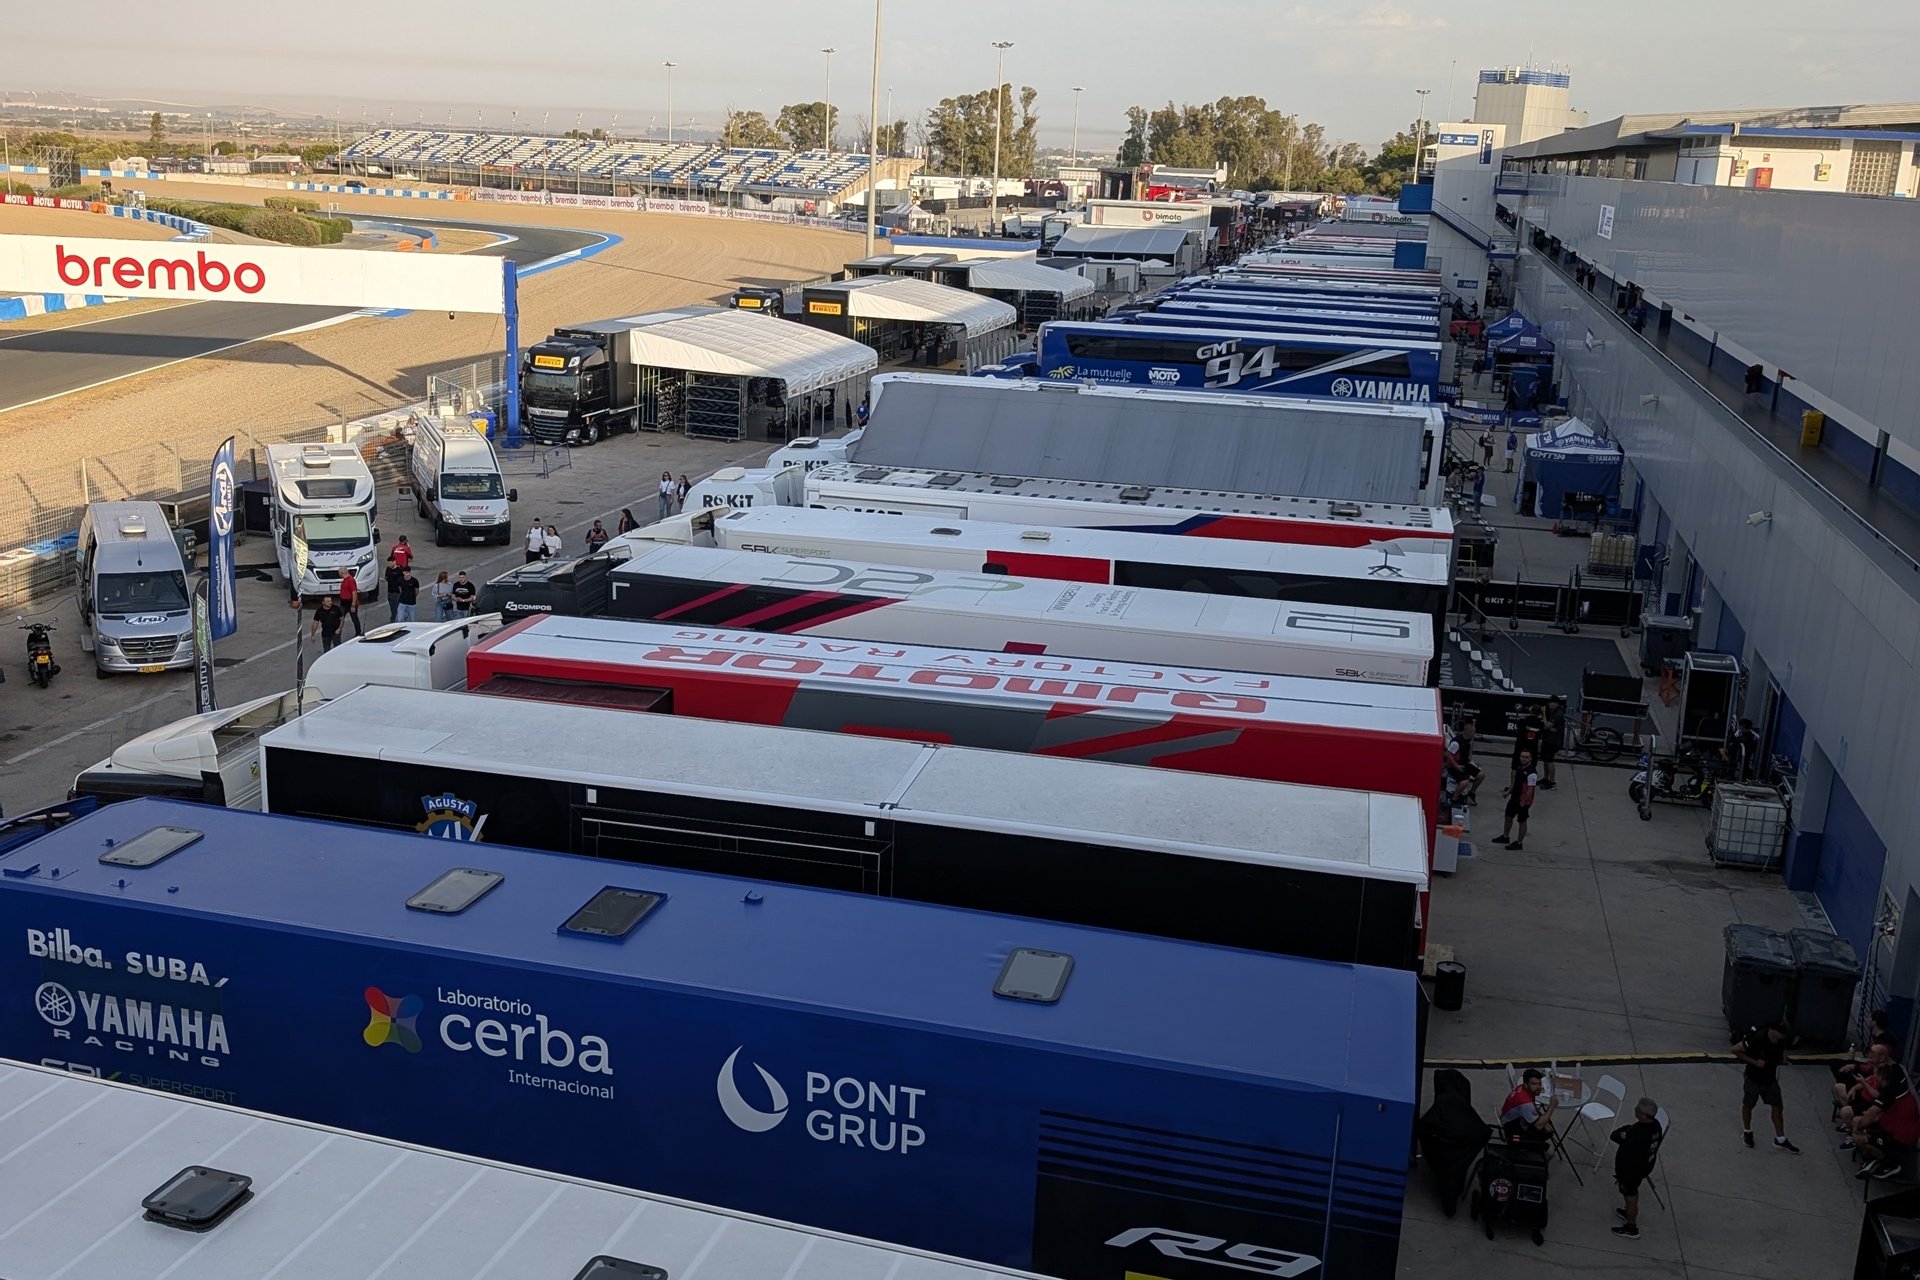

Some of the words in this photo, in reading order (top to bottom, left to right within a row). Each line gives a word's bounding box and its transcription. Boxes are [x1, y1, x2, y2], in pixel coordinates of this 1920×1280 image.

[5, 194, 28, 205] MOTUL
[33, 196, 55, 207] MOTUL
[497, 192, 517, 201] brembo
[520, 193, 542, 203] brembo
[555, 195, 578, 205] brembo
[582, 197, 606, 207] brembo
[60, 198, 83, 210] MOTUL
[610, 199, 635, 209] brembo
[649, 201, 675, 211] brembo
[679, 202, 706, 213] brembo
[1155, 212, 1182, 221] bimota
[55, 243, 266, 294] brembo
[812, 304, 838, 313] PIRELLI
[1196, 338, 1242, 360] GMT
[537, 357, 562, 367] PIRELLI
[1203, 345, 1280, 389] 94
[1077, 365, 1089, 376] La
[1090, 366, 1132, 379] mutuelle
[1148, 369, 1181, 381] MOTO
[1354, 380, 1431, 402] YAMAHA
[1564, 434, 1596, 446] YAMAHA
[1595, 454, 1620, 462] YAMAHA
[131, 615, 163, 624] Arai
[671, 630, 907, 659] RACING
[934, 652, 1270, 690] FACTORY
[1335, 668, 1367, 679] SBK
[1368, 671, 1410, 679] SUPERSPORT
[641, 645, 1267, 714] QJMOTOR
[428, 798, 470, 814] AGUSTA
[27, 927, 112, 969] Bilba.
[437, 986, 532, 1016] Laboratorio
[77, 990, 231, 1055] YAMAHA
[53, 1028, 220, 1067] RACING
[438, 1007, 614, 1076] cerba
[129, 1072, 237, 1103] SUPERSPORT
[507, 1068, 615, 1100] Internacional
[805, 1070, 927, 1120] PONT
[805, 1109, 927, 1155] GRUP
[1103, 1227, 1322, 1279] R9
